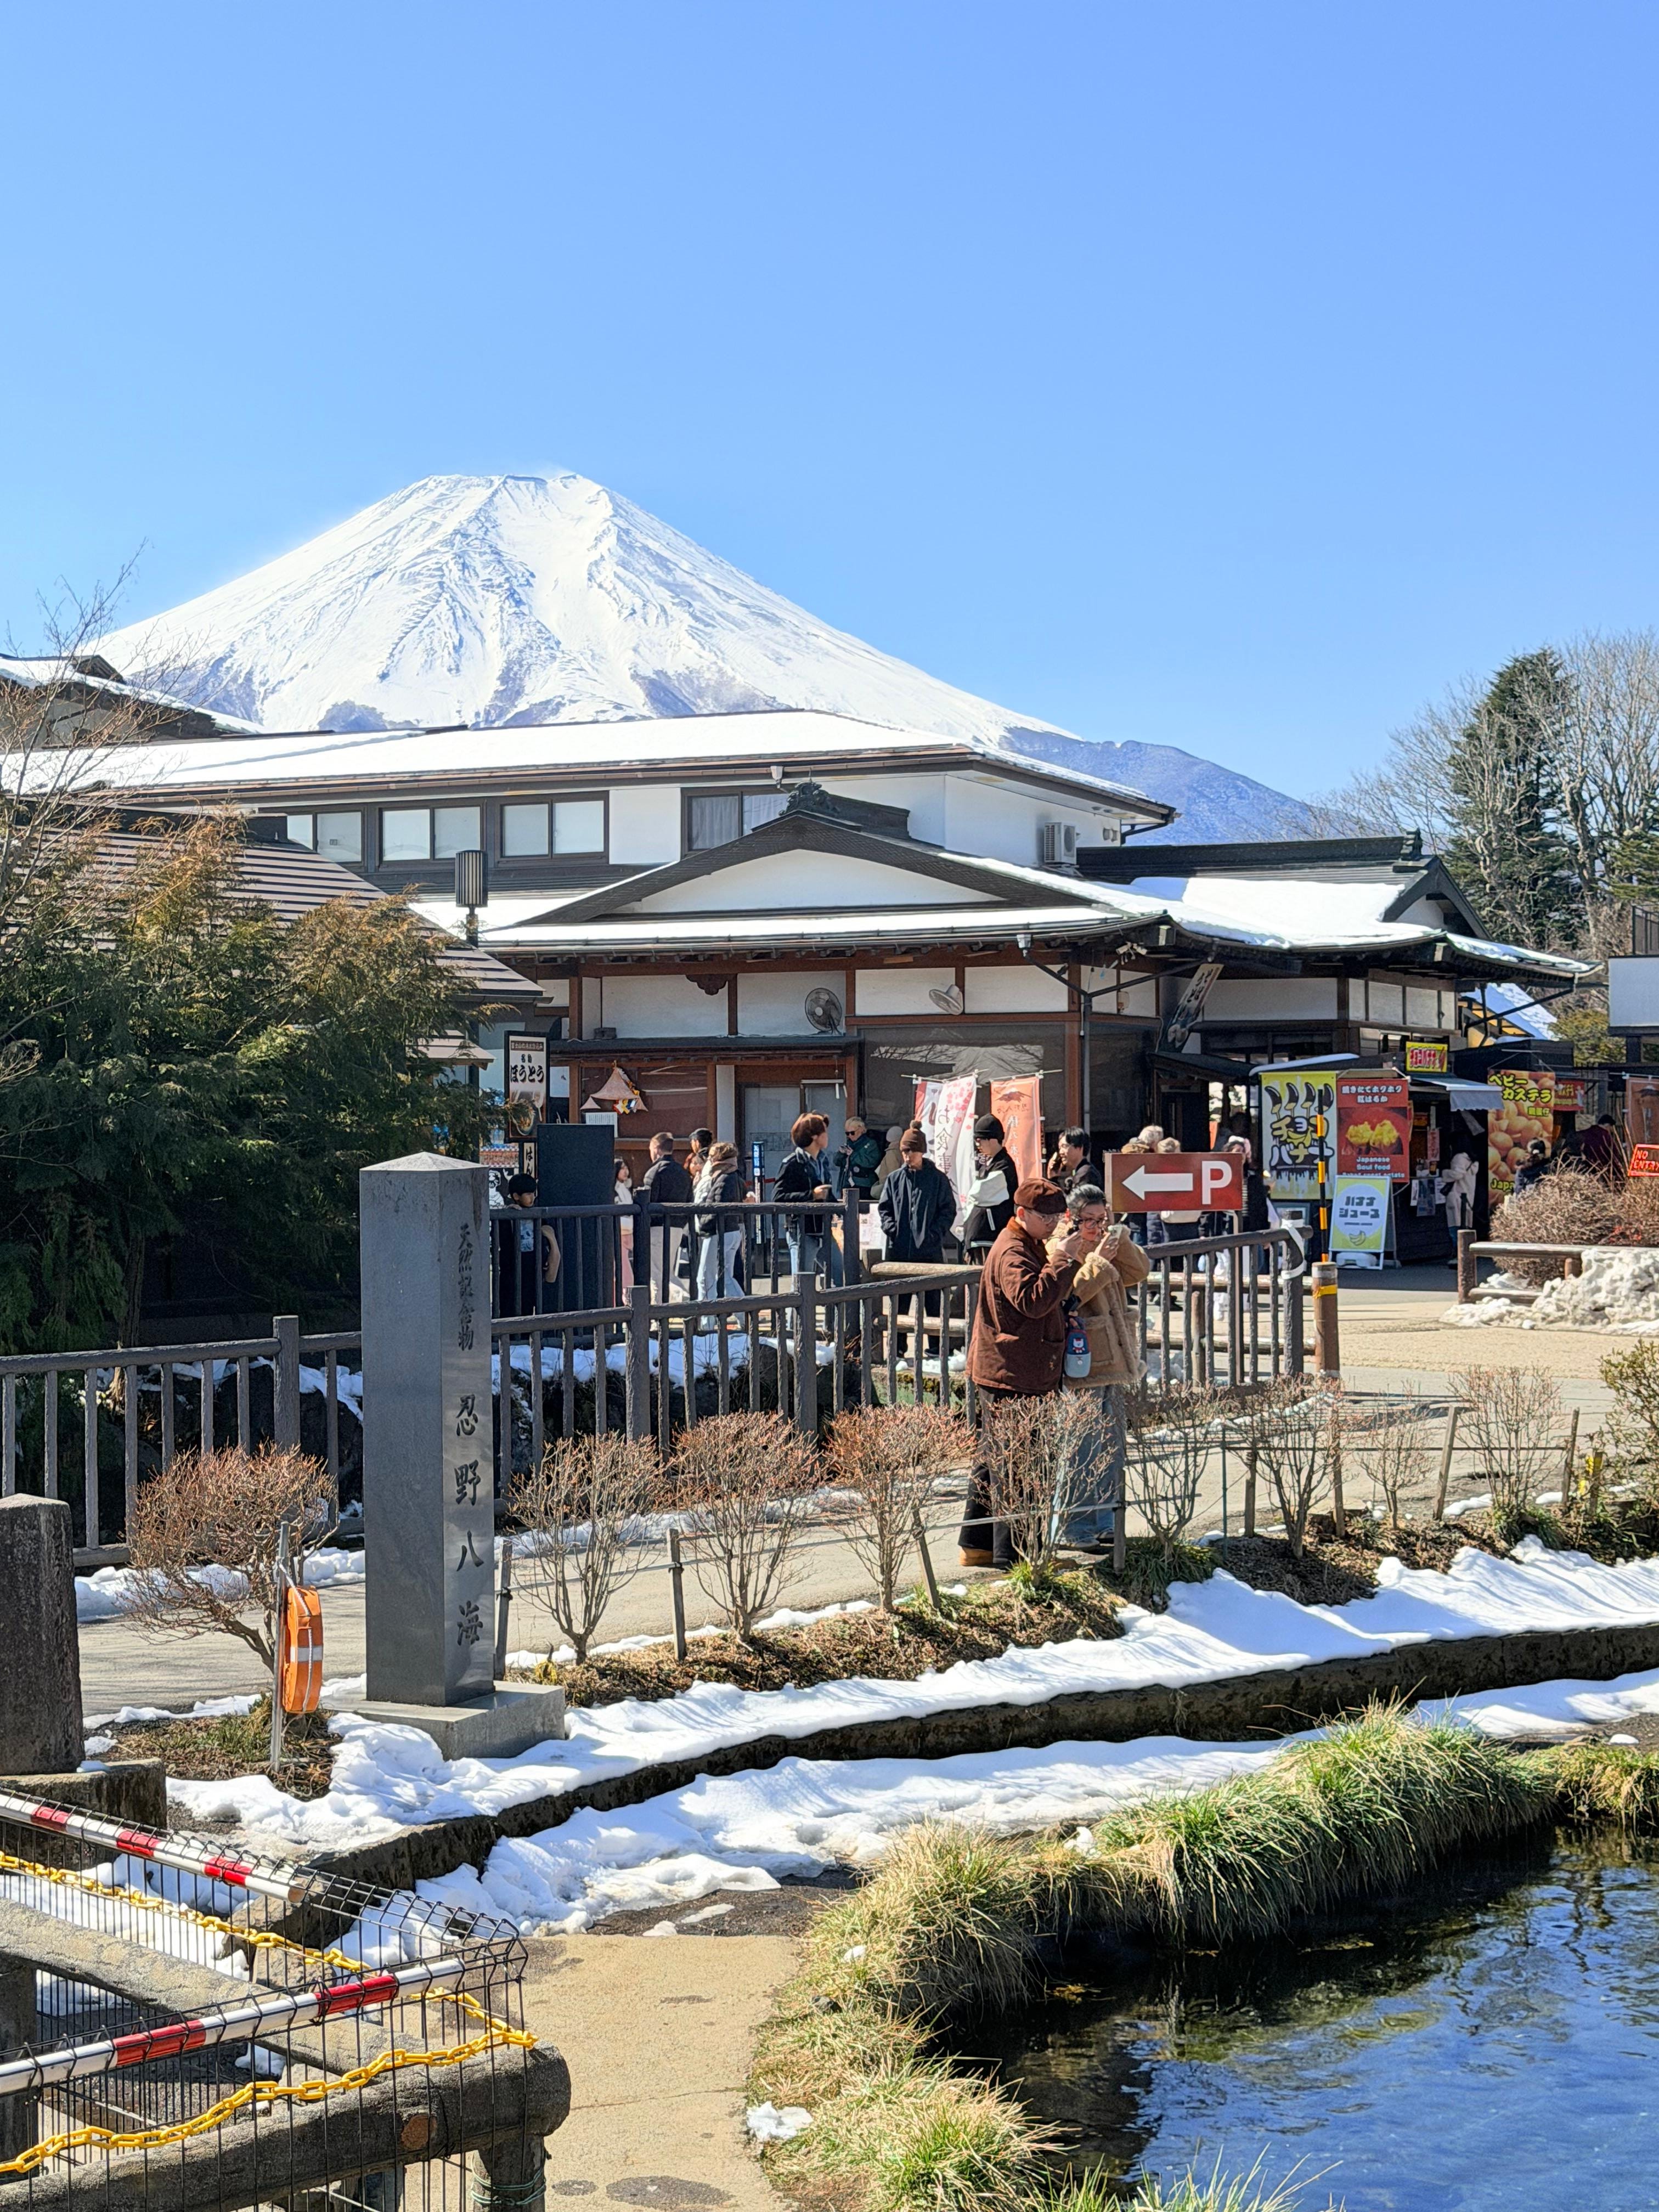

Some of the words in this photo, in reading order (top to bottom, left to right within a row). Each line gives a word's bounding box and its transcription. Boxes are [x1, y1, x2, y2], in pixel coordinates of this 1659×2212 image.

[511, 1064, 544, 1084] ほうとう
[1489, 1074, 1527, 1087] ベビー
[1502, 1087, 1552, 1103] カステラ
[1636, 1150, 1648, 1159] NO
[1202, 1161, 1232, 1205] P
[1339, 1208, 1380, 1218] ジュース
[458, 1223, 475, 1351] 天然記念物
[455, 1393, 484, 1646] 忍野八海
